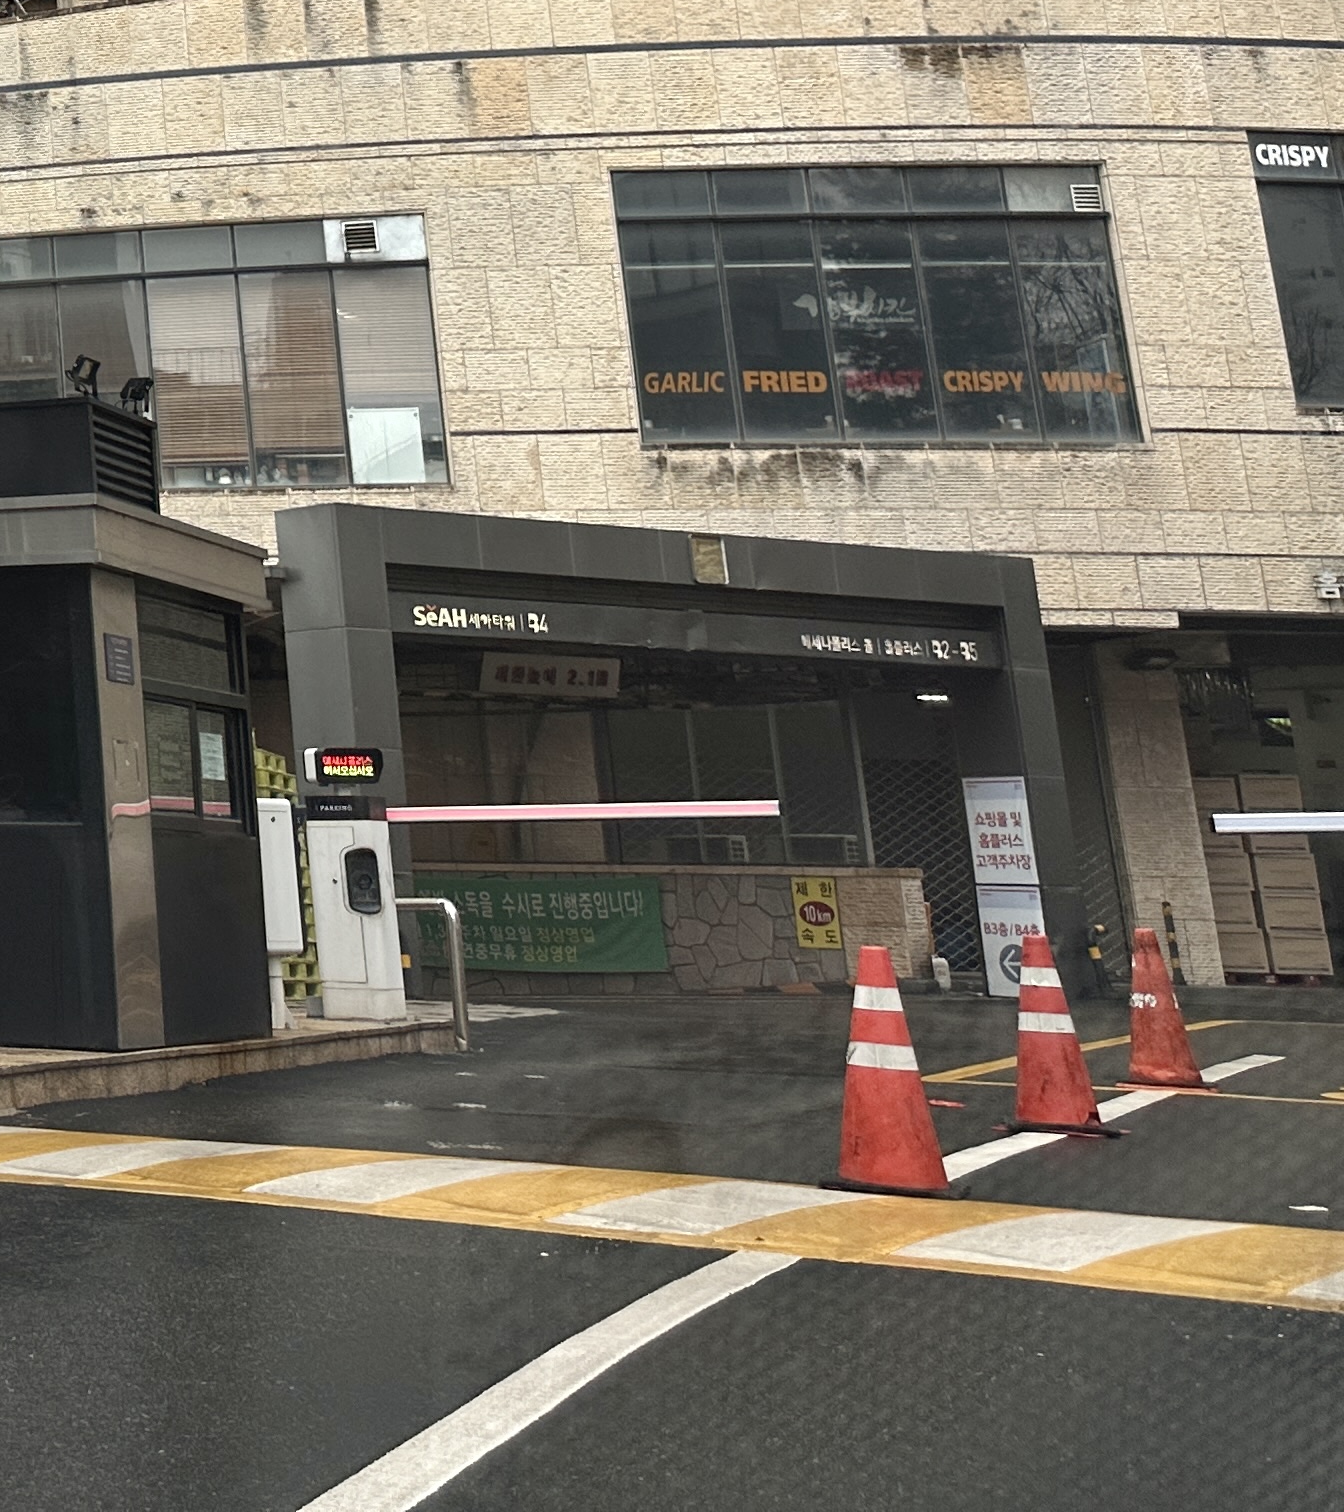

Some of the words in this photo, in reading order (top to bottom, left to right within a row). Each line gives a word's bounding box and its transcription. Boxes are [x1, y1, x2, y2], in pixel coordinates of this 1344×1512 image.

[1255, 143, 1329, 168] CRISPY
[644, 370, 725, 394] GARLIC
[742, 370, 827, 393] FRIED
[943, 370, 1025, 393] CRISPY
[1042, 371, 1127, 394] WING
[468, 613, 516, 631] 세아타워
[801, 634, 861, 652] 메세나폴리스
[884, 639, 923, 656] 홈플러스
[323, 765, 374, 776] 어서오십시오
[319, 804, 353, 812] PARKING
[975, 811, 1008, 827] 쇼핑몰
[1010, 811, 1022, 827] 및
[978, 832, 1024, 848] 홈플러스
[976, 854, 1031, 870] 고객주차장
[501, 891, 547, 919] 수시로
[549, 890, 644, 920] 진행중입니다!
[802, 905, 832, 923] 10km
[489, 925, 532, 943] 일요일
[536, 926, 595, 943] 정상영업
[521, 944, 577, 962] 정상영업
